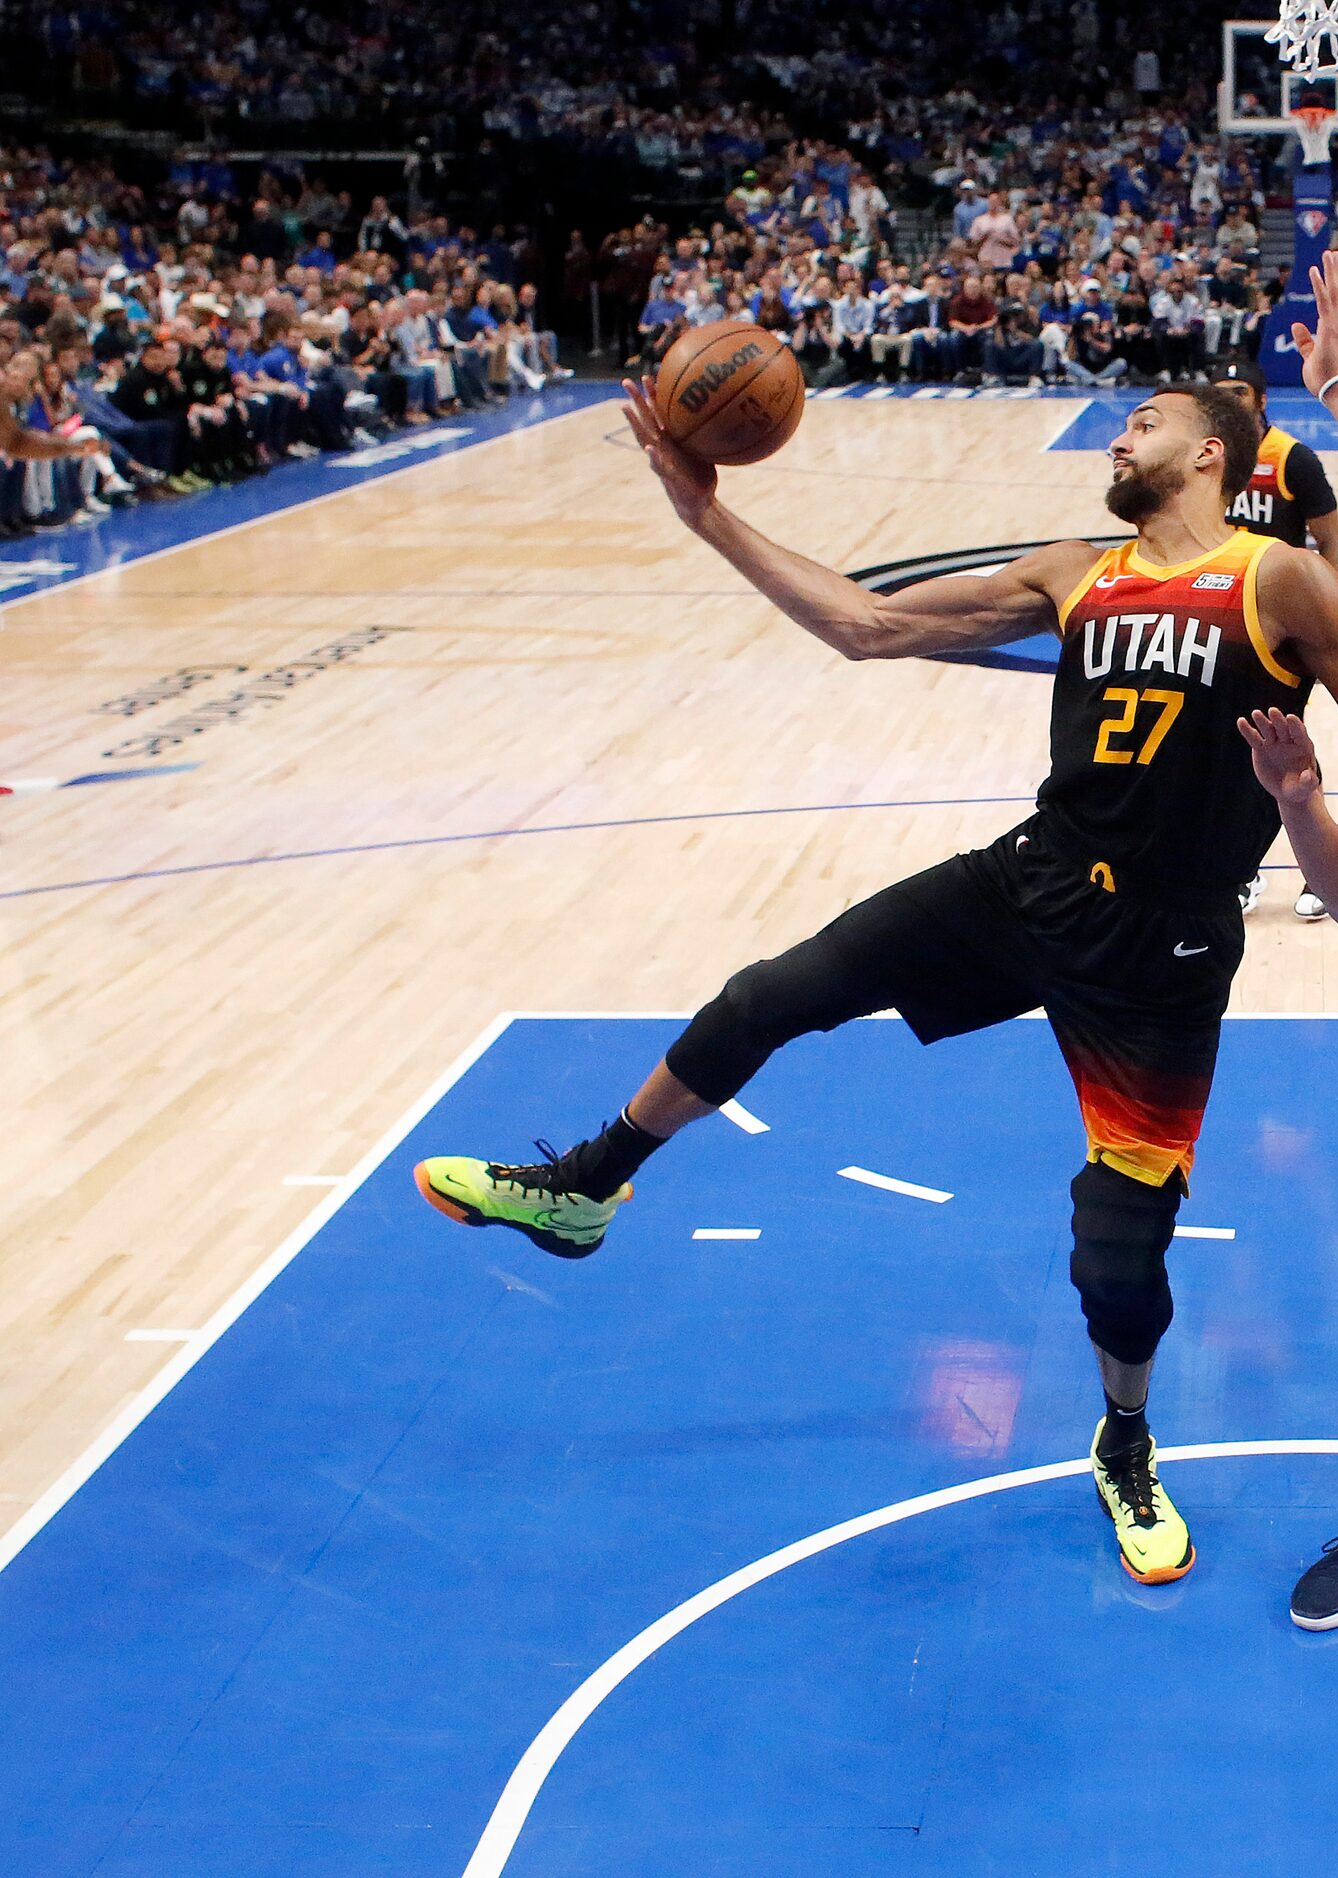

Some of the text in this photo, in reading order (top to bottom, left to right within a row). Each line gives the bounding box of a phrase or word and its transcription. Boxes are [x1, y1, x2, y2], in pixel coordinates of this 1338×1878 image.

[678, 343, 763, 413] Wilson
[1083, 613, 1222, 687] UTAH
[1093, 687, 1185, 765] 27
